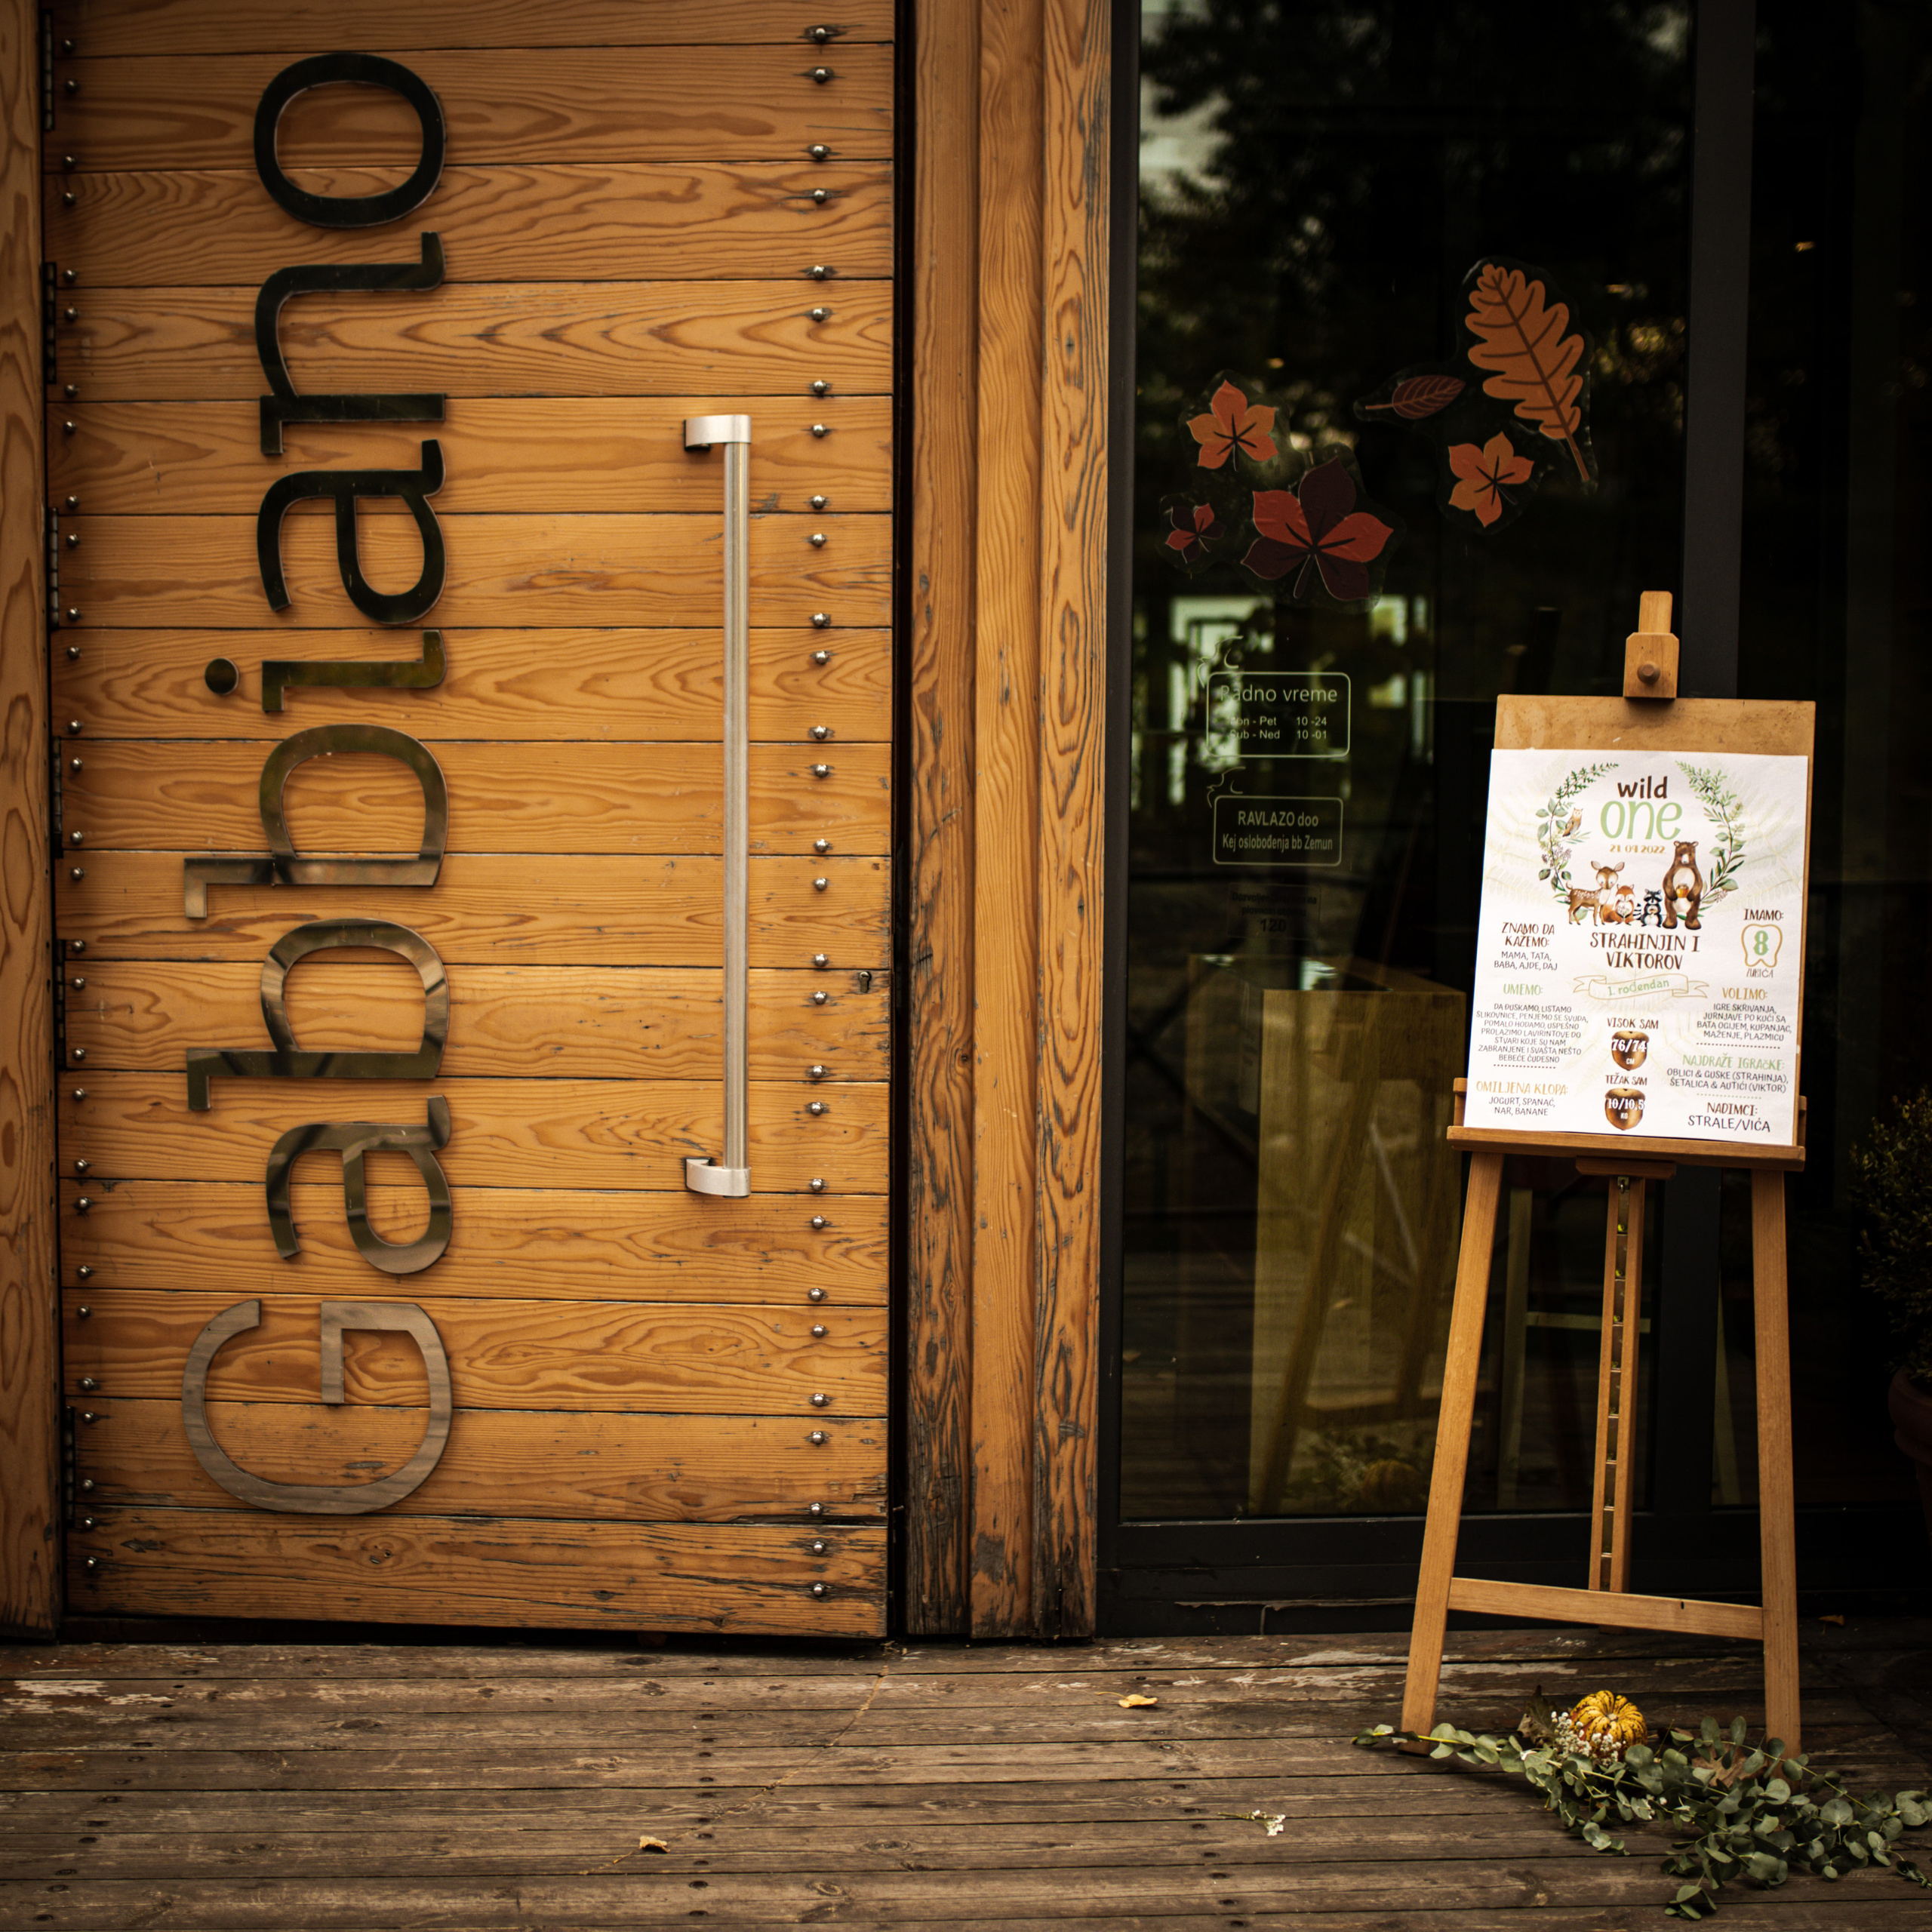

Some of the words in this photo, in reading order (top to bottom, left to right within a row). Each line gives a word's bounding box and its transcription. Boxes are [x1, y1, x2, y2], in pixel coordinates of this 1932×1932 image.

[1220, 684, 1277, 702] Radno
[1283, 689, 1337, 702] vreme
[1260, 717, 1277, 726] Pet
[1297, 717, 1308, 726] 10
[1260, 730, 1280, 739] Ned
[1297, 731, 1309, 739] 10
[182, 51, 454, 1515] Gabbiano
[1617, 776, 1668, 798] wild
[1238, 811, 1295, 826] RAVLAZO
[1297, 812, 1318, 827] doo
[1600, 800, 1683, 840] one
[1223, 834, 1237, 852] Kej
[1239, 834, 1289, 853] oslobođenja
[1292, 835, 1302, 849] bb
[1305, 835, 1333, 850] Zemun
[1743, 909, 1783, 921] IMAMO:
[1260, 918, 1286, 932] 120
[1502, 922, 1539, 934] ZNAMO
[1543, 924, 1555, 935] DA
[1590, 932, 1686, 951] STRAHINJIN
[1691, 936, 1700, 952] I
[1753, 930, 1769, 955] 8
[1502, 951, 1528, 961] MAMA,
[1531, 952, 1552, 961] TATA,
[1607, 952, 1683, 970] VIKTOROV
[1494, 961, 1517, 970] BABA,
[1519, 961, 1541, 971] AJDE,
[1543, 962, 1558, 971] DAJ
[1503, 983, 1543, 995] UMEMO:
[1607, 986, 1616, 996] 1.
[1619, 979, 1669, 994] rođendan
[1722, 987, 1767, 1000] VOLIMO:
[1713, 1003, 1730, 1011] IGRE
[1732, 1004, 1777, 1014] SKRIVANJA,
[1476, 1011, 1518, 1020] SLIKOVNICE,
[1519, 1013, 1552, 1021] PENJEMO
[1703, 1012, 1742, 1021] JURNJAVE
[1757, 1013, 1774, 1022] KUĆI
[1776, 1014, 1786, 1023] SA
[1515, 1021, 1546, 1029] HODAMO,
[1547, 1022, 1579, 1030] USPEŠNO
[1607, 1017, 1636, 1028] VISOK
[1640, 1019, 1659, 1029] SAM
[1524, 1029, 1569, 1038] LAVIRINTOVE
[1704, 1030, 1742, 1040] MAŽENJE,
[1745, 1032, 1784, 1041] PLAZMICU
[1478, 1044, 1525, 1054] ZABRANJENE
[1612, 1039, 1647, 1052] 76/74
[1499, 1054, 1525, 1062] BEBEĆE
[1683, 1053, 1733, 1068] NAJDRAŽE
[1605, 1072, 1629, 1084] TEŽAK
[1632, 1076, 1647, 1085] SAM
[1667, 1068, 1693, 1077] OBLICI
[1704, 1070, 1730, 1079] GUSKE
[1733, 1071, 1789, 1084] (STRAHINJA),
[1476, 1081, 1530, 1094] OMILJENA
[1534, 1083, 1568, 1095] KLOPA:
[1670, 1078, 1709, 1088] ŠETALICA
[1711, 1081, 1718, 1089] &
[1720, 1081, 1747, 1091] AUTIĆI
[1749, 1082, 1786, 1094] (VIKTOR)
[1489, 1097, 1521, 1106] JOGURT,
[1607, 1098, 1644, 1111] 10/10,5
[1494, 1107, 1513, 1115] NAR,
[1515, 1107, 1549, 1115] BANANE
[1707, 1102, 1758, 1116] NADIMCI:
[1688, 1115, 1770, 1132] STRALE/VIĆA
